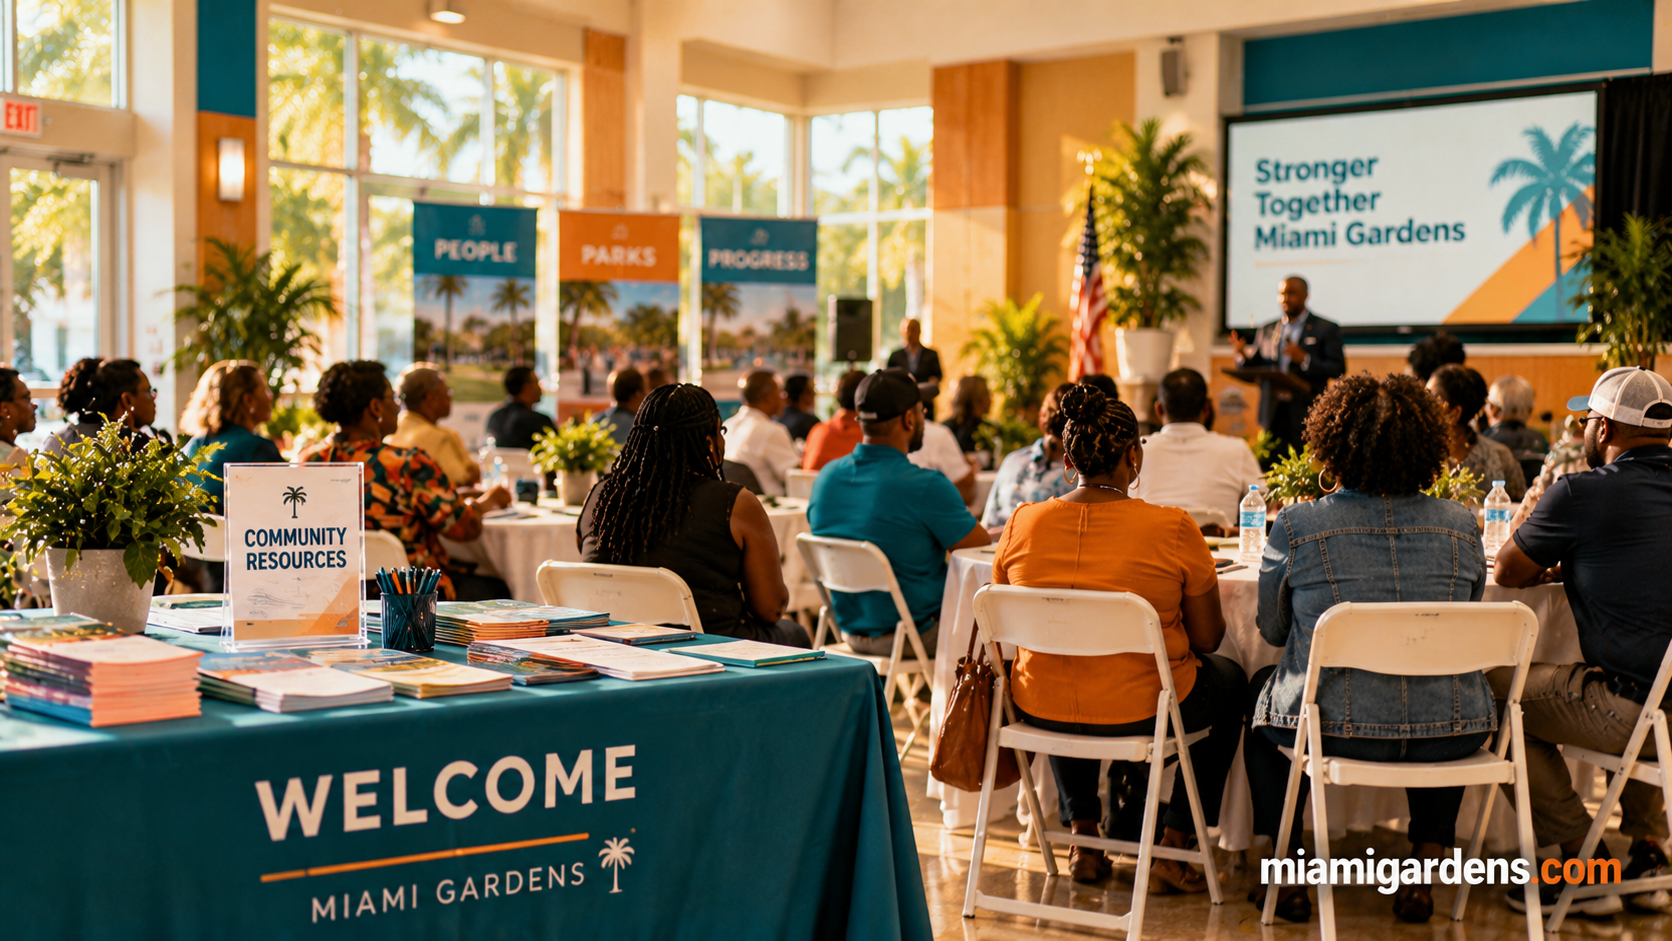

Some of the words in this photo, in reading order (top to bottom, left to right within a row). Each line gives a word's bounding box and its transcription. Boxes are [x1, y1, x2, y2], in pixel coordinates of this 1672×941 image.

[6, 102, 38, 132] EXIT
[1256, 157, 1379, 185] Stronger
[1255, 188, 1381, 221] Together
[1255, 221, 1337, 249] Miami
[1346, 218, 1465, 246] Gardens
[434, 238, 518, 264] PEOPLE
[581, 244, 657, 268] PARKS
[708, 248, 810, 271] PROGRESS
[244, 527, 347, 547] COMMUNITY
[246, 550, 347, 570] RESOURCES
[254, 744, 636, 842] WELCOME
[311, 884, 418, 923] MIAMI
[436, 862, 585, 904] GARDENS
